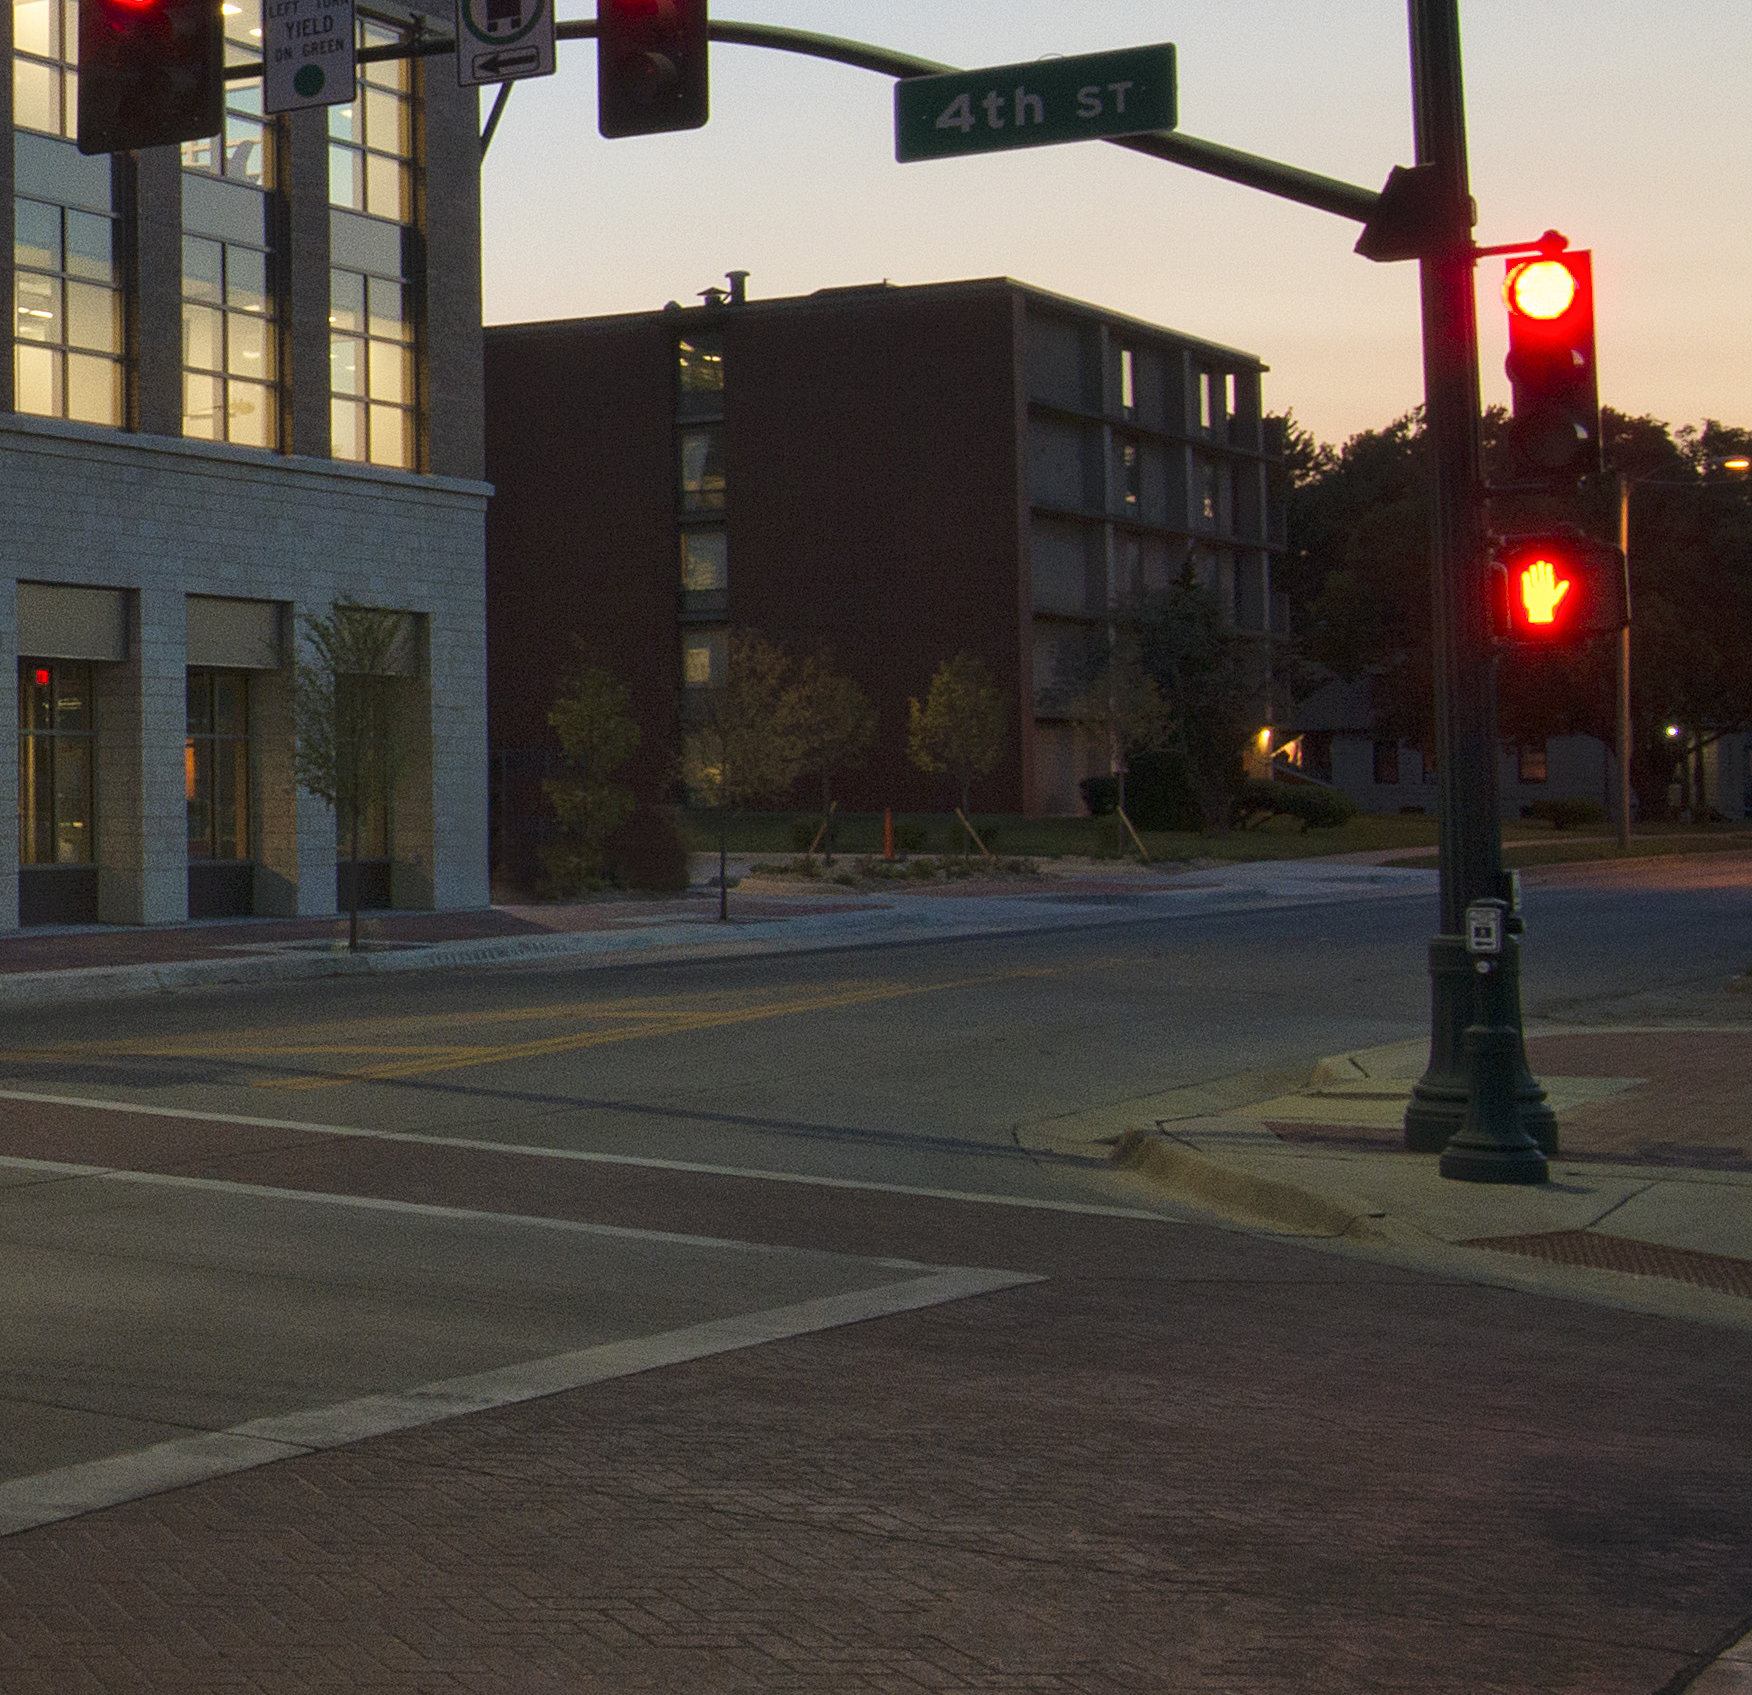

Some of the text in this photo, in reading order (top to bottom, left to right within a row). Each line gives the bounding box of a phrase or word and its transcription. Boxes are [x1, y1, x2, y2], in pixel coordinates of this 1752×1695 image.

[268, 0, 300, 19] LEFT
[286, 14, 334, 40] YIELD
[275, 39, 345, 63] ON GREEN
[935, 80, 1134, 133] 4th ST
